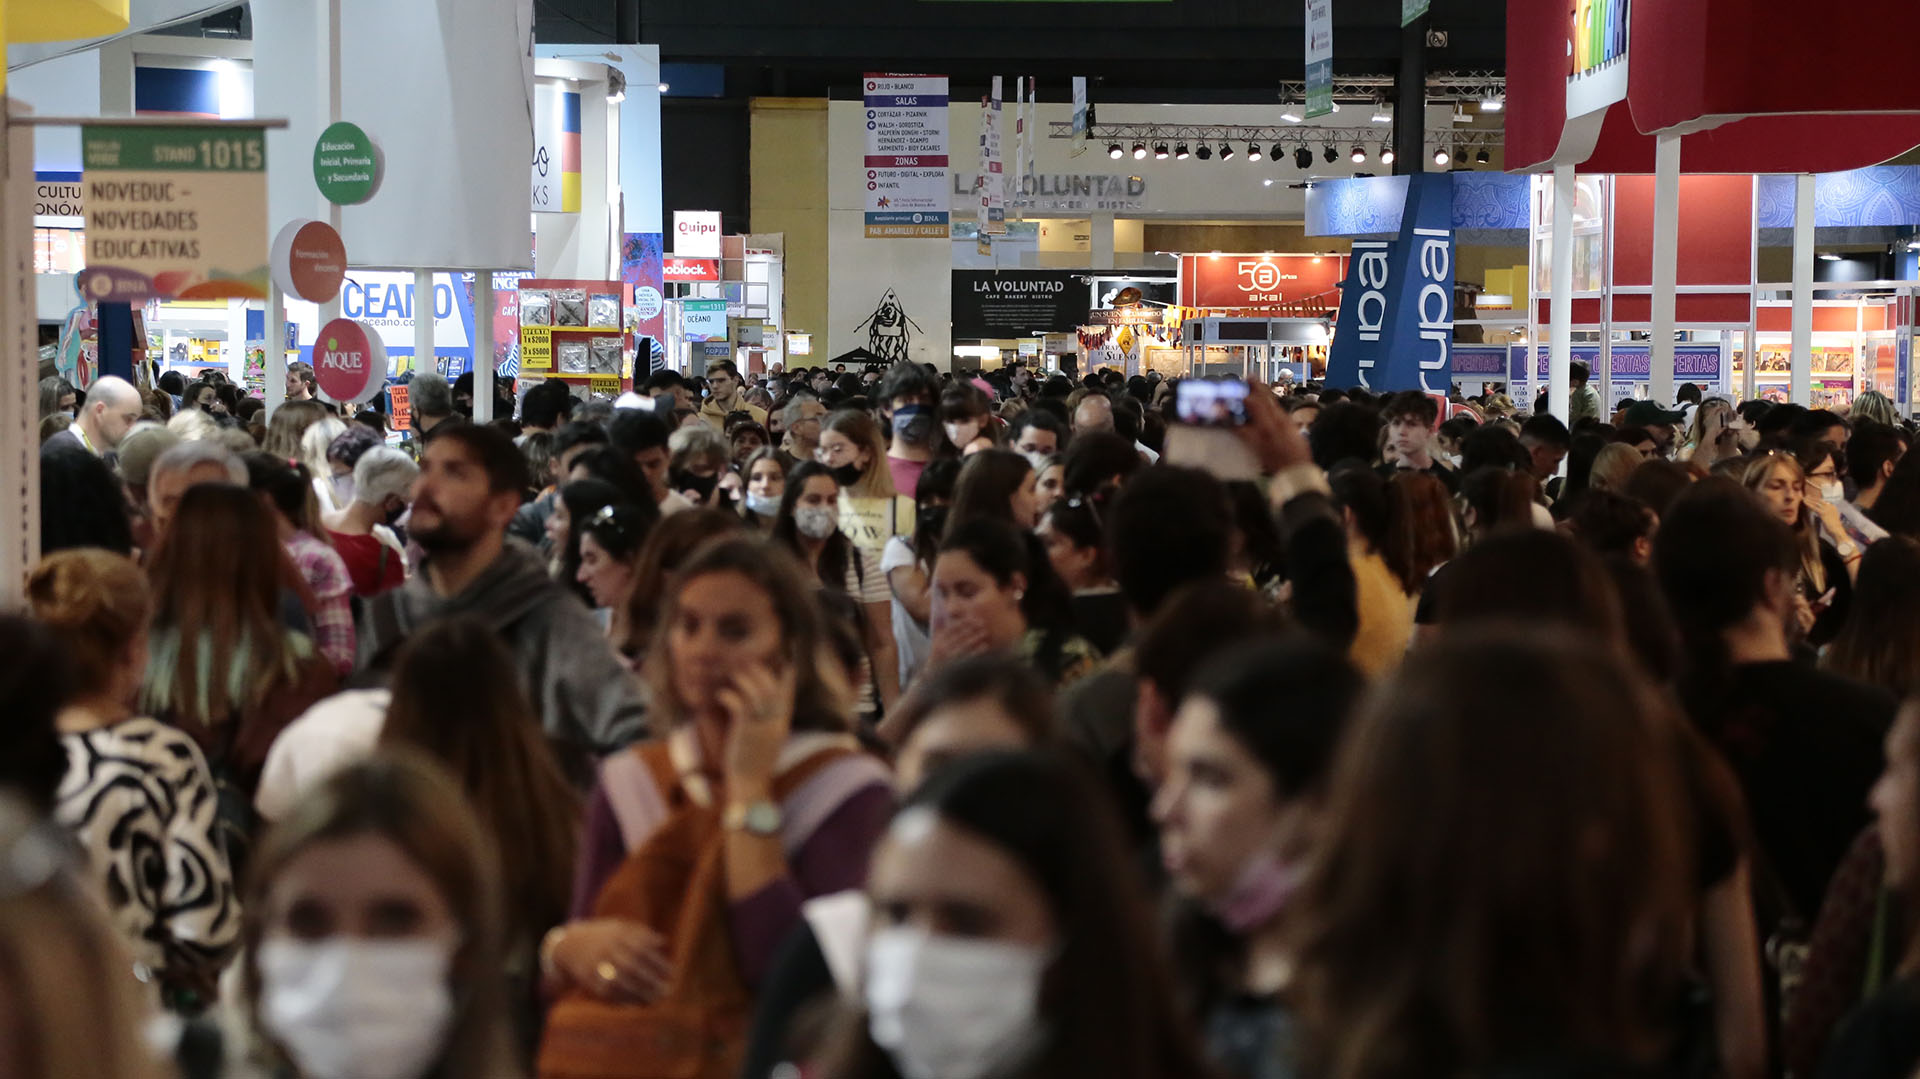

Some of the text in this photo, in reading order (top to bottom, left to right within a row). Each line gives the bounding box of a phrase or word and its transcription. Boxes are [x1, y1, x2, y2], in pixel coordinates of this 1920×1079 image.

[896, 97, 917, 105] SALAS
[321, 142, 355, 152] Educación
[154, 140, 262, 169] STAND 1015
[320, 156, 371, 167] Inicial, Primaria
[895, 157, 918, 166] ZONAS
[333, 172, 370, 182] Secundaria
[37, 185, 84, 199] CULTU
[91, 182, 175, 202] NOVEDUC
[1002, 174, 1146, 197] VOLUNTAD
[34, 201, 83, 216] ONÓM
[92, 211, 198, 231] NOVEDADES
[678, 222, 716, 235] Quipu
[93, 240, 201, 259] EDUCATIVAS
[973, 281, 1064, 292] LA VOLUNTAD
[343, 283, 453, 320] CEAO
[1248, 292, 1283, 302] akal
[687, 313, 711, 324] OCÉANO
[532, 336, 549, 344] $2000
[321, 350, 363, 371] AIQUE
[1104, 350, 1137, 361] SUEO
[1592, 354, 1650, 373] OERTAS
[1673, 354, 1718, 373] ERTAS
